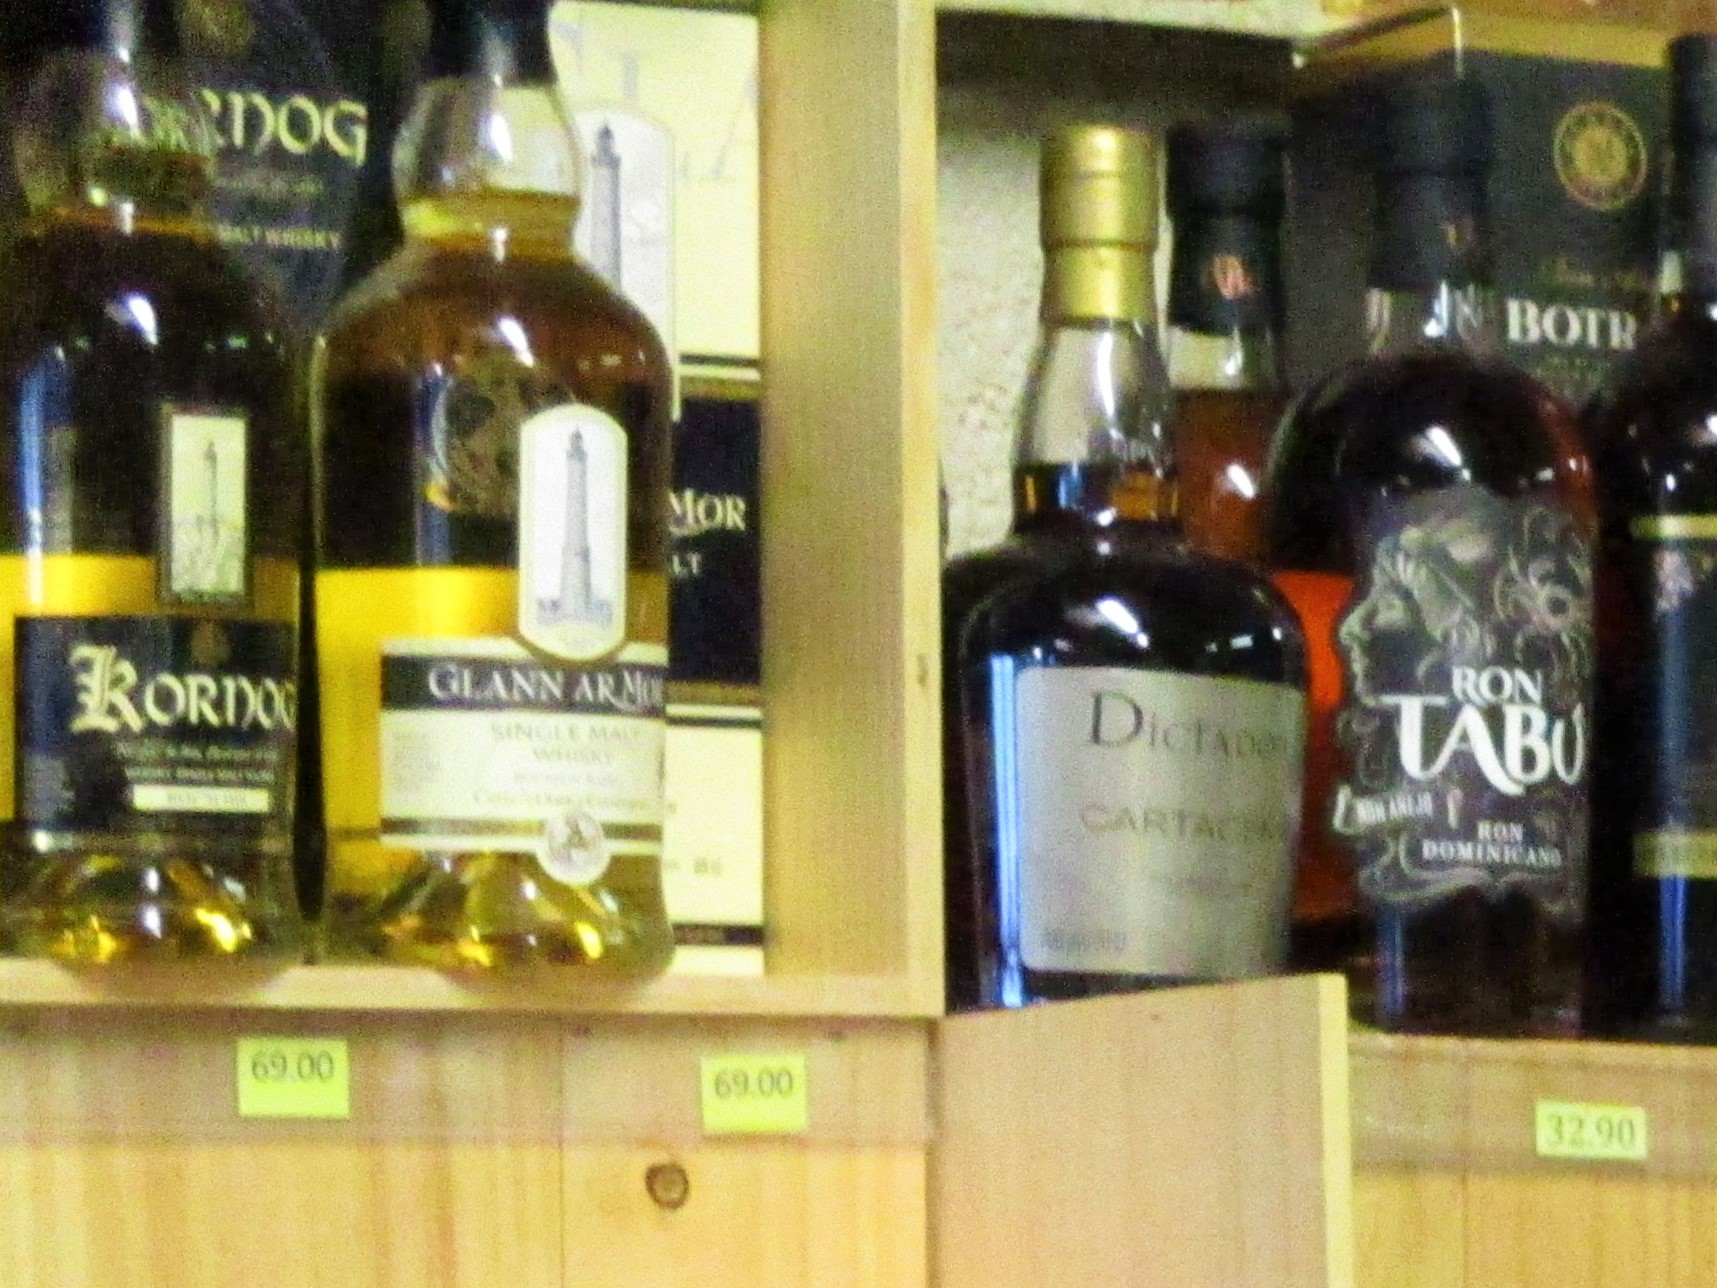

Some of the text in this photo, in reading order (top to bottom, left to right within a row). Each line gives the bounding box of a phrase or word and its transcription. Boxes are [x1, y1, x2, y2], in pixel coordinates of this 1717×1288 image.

[429, 664, 563, 703] GLANN
[1453, 664, 1544, 703] RON
[1380, 695, 1588, 798] TABU
[250, 1051, 335, 1085] 69.00
